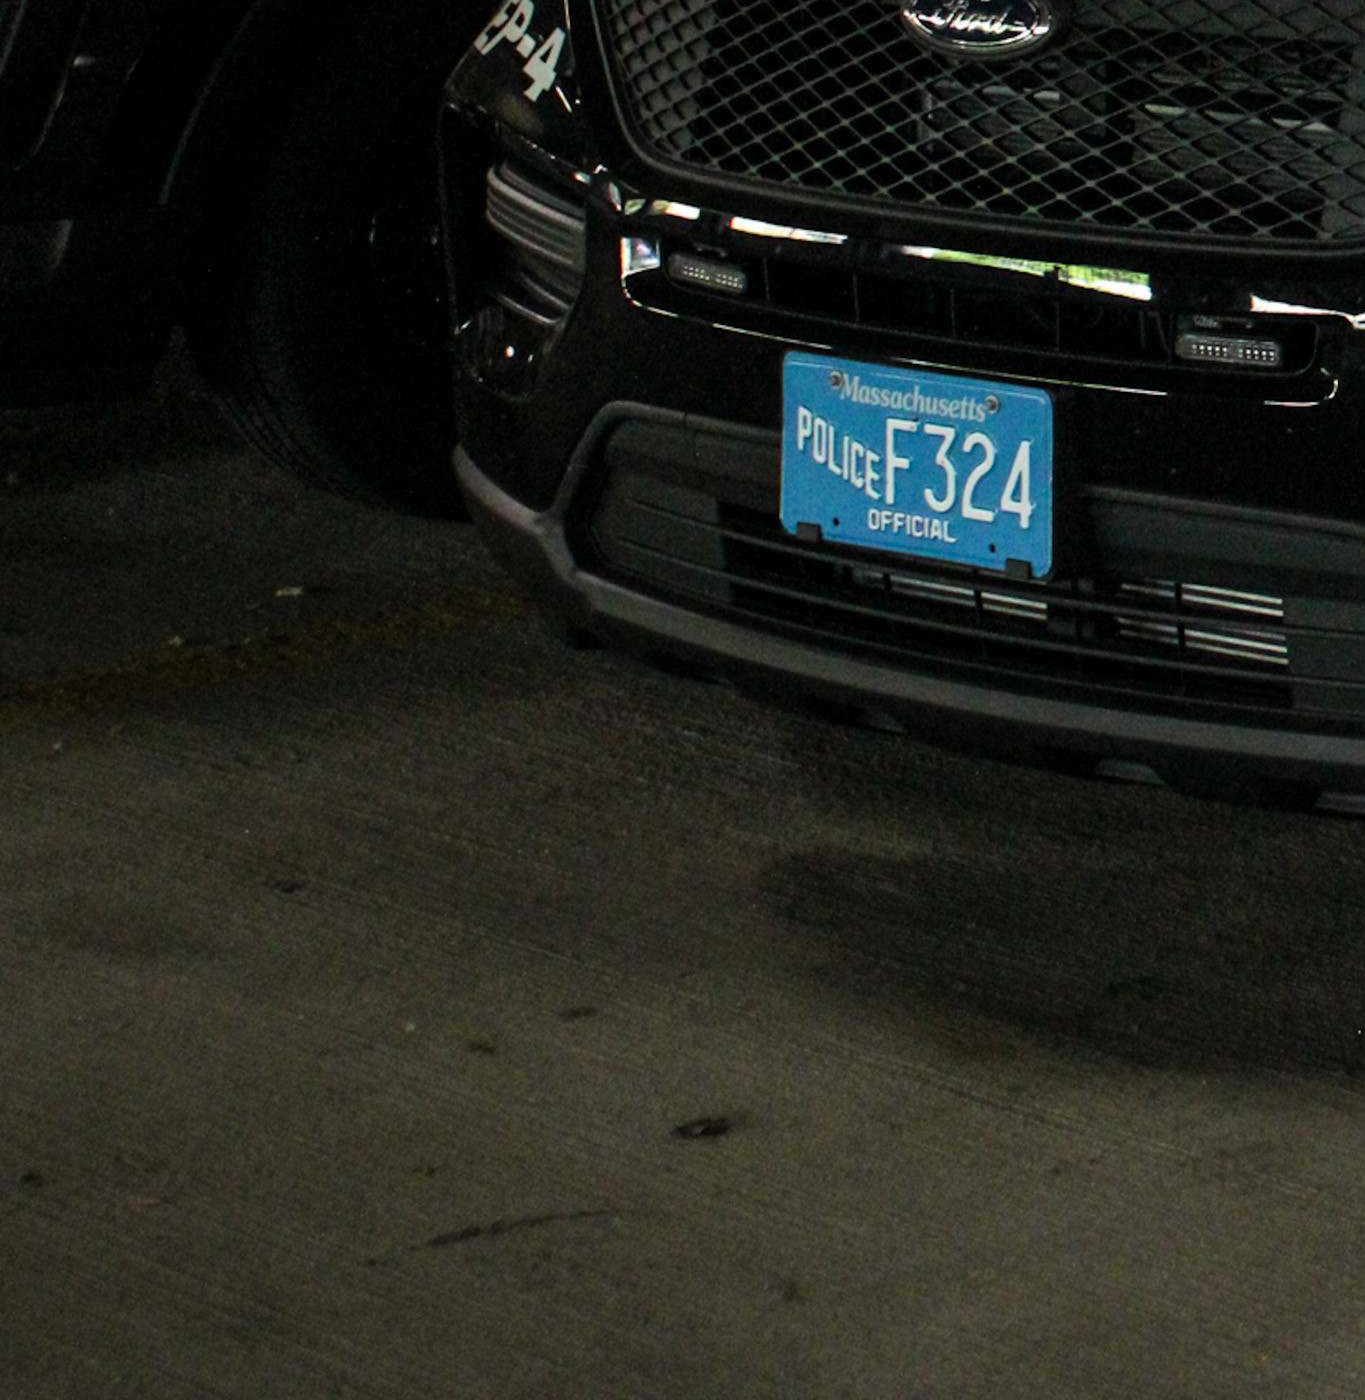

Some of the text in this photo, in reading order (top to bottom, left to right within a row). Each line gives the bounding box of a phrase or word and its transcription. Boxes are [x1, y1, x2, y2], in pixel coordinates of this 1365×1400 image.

[840, 373, 987, 423] Massachusetts
[797, 406, 1036, 530] POLICE F324
[867, 508, 957, 543] OFFICIAL
